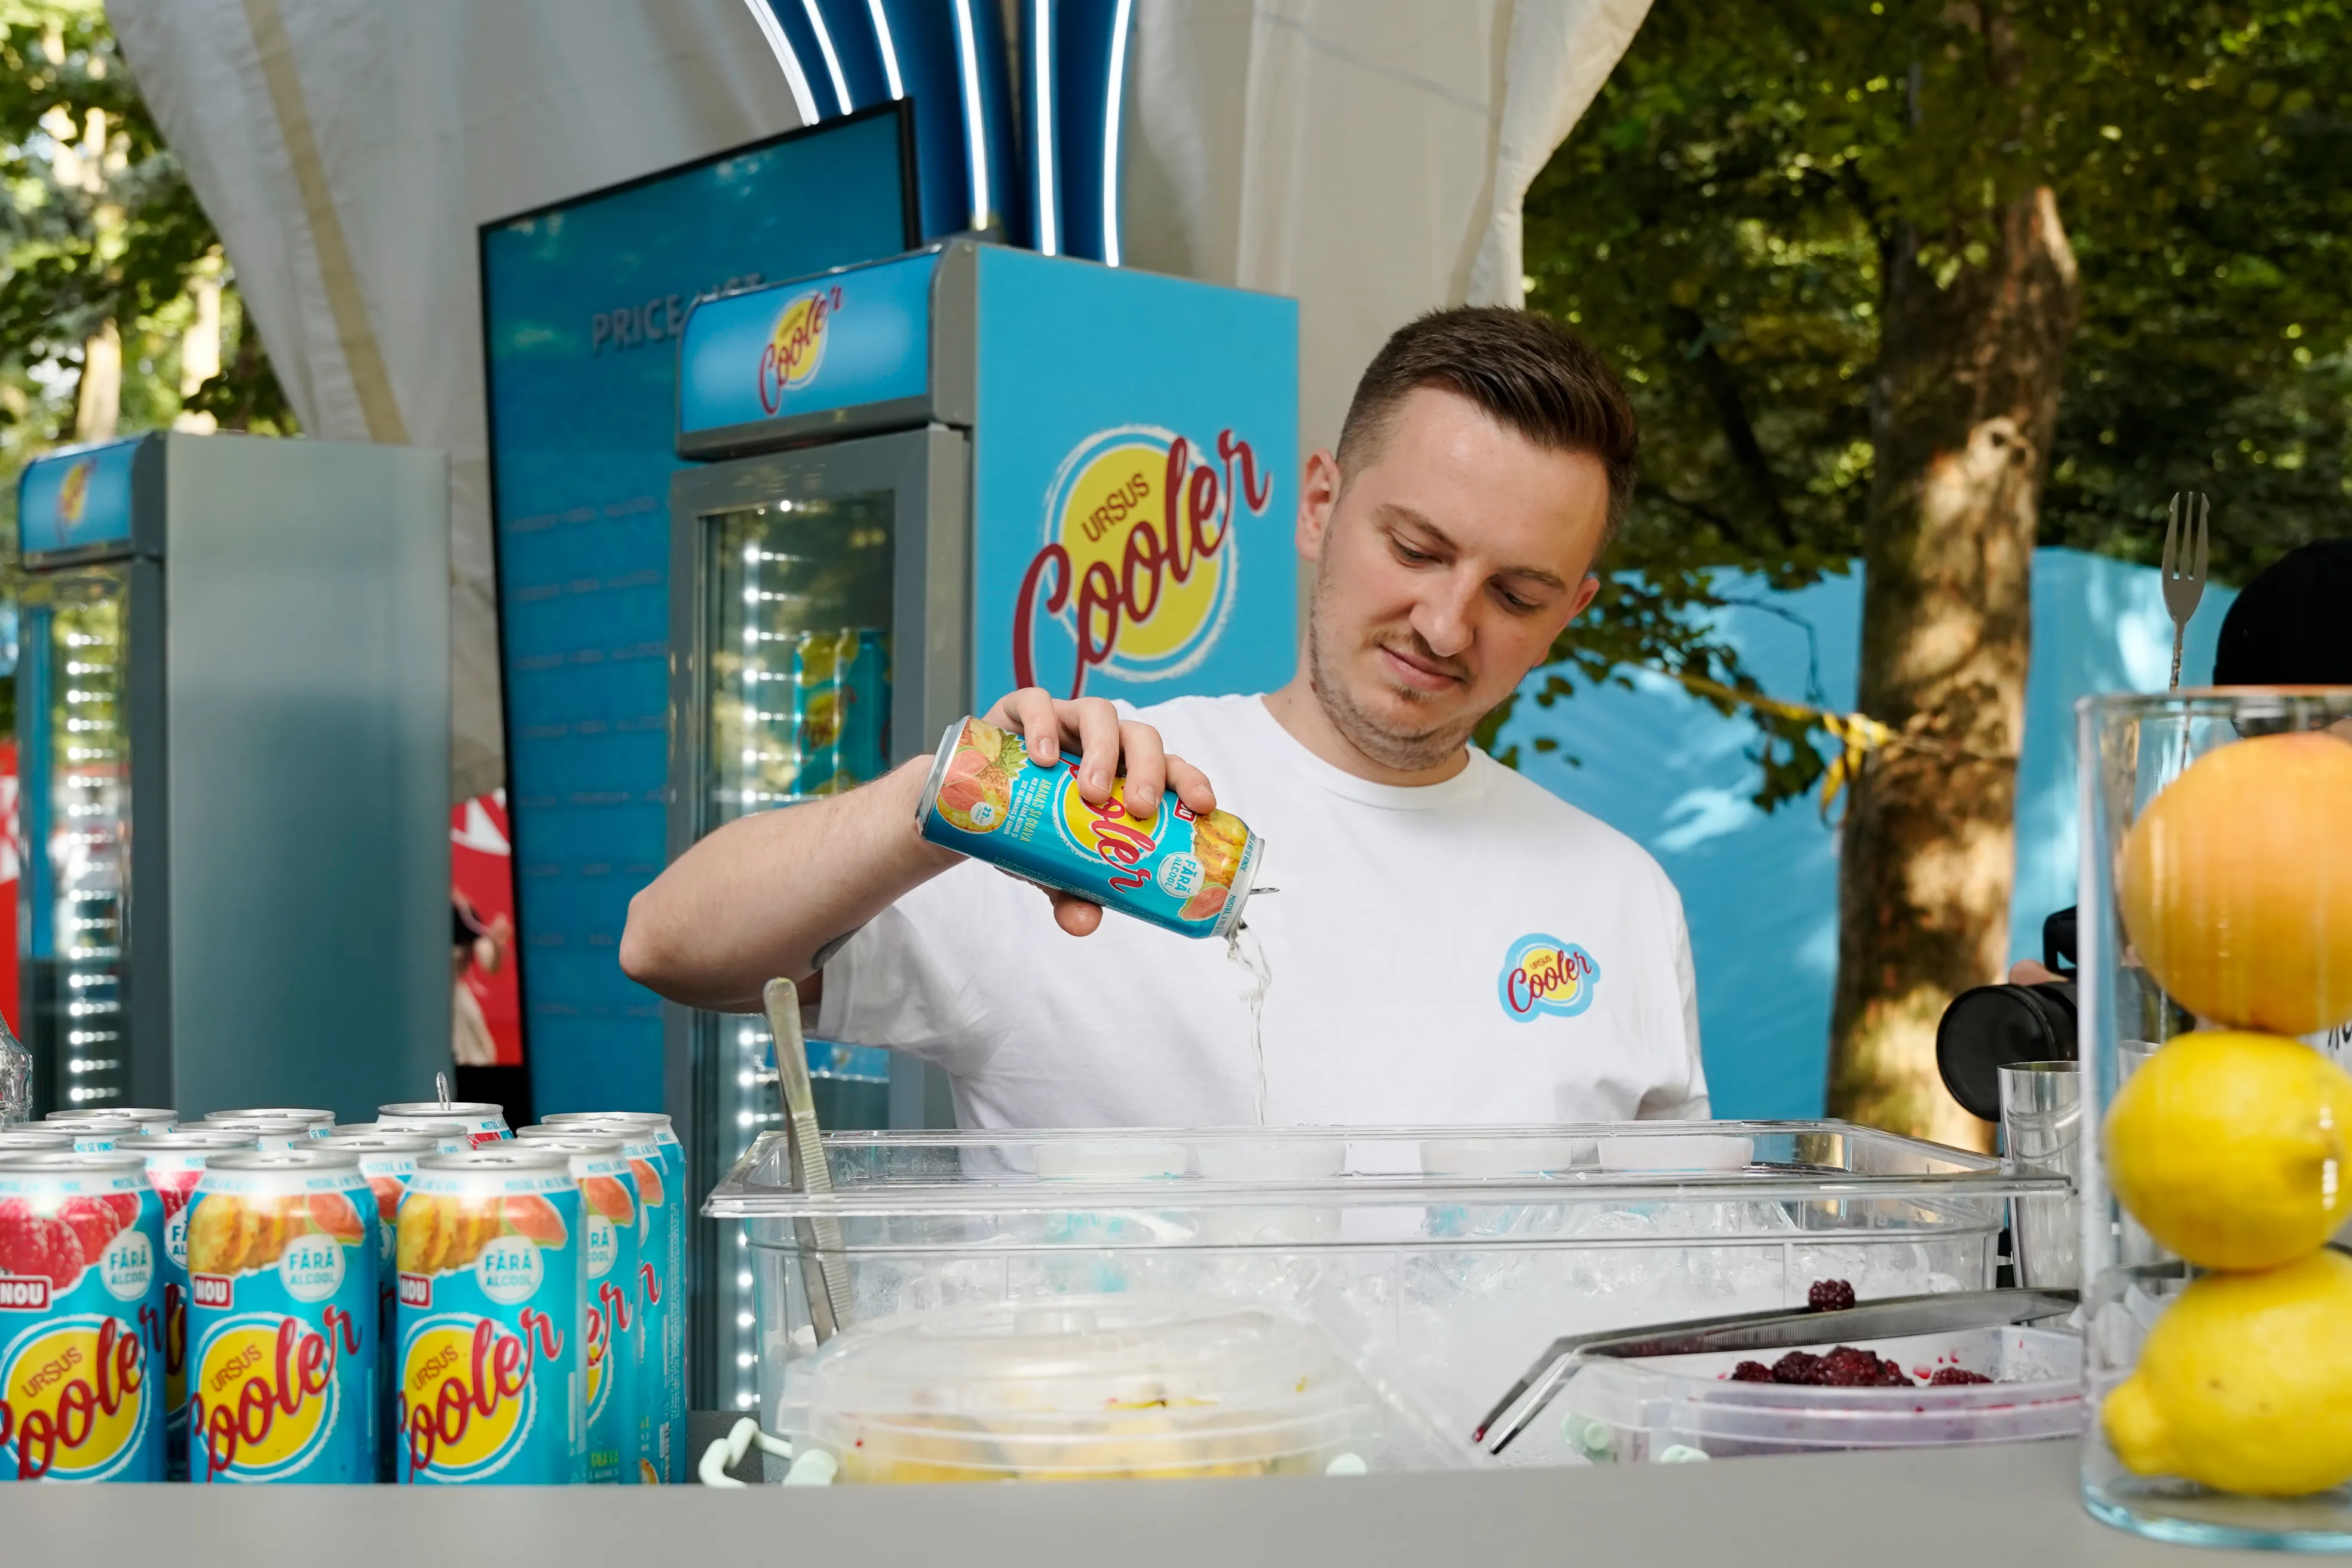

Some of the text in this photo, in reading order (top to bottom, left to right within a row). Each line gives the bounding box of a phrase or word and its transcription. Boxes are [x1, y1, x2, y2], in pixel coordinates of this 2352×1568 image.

[593, 294, 681, 349] PRICE
[1081, 472, 1150, 542] URSUS
[1013, 428, 1270, 700] Cooler
[1011, 795, 1022, 815] ANANAS
[1032, 777, 1052, 810] ANANAS
[1003, 820, 1013, 835] GUAVA
[1019, 818, 1039, 842] GUAVA
[1164, 856, 1179, 887] ALCOOL
[1175, 859, 1197, 894] FĂRĂ
[1529, 954, 1552, 969] URSUS
[1508, 950, 1591, 1012] Cooler
[590, 1227, 610, 1248] RĂ
[110, 1244, 148, 1270] FĂRĂ
[289, 1246, 334, 1270] FĂRĂ
[485, 1249, 532, 1271] FĂRĂ
[111, 1269, 149, 1285] ALCOOL
[290, 1272, 334, 1285] ALCOOL
[486, 1274, 532, 1286] ALCOOL
[0, 1282, 44, 1305] NOU
[195, 1279, 228, 1303] NOU
[401, 1278, 427, 1303] NOU
[21, 1346, 82, 1397] URSUS
[210, 1343, 262, 1392] URSUS
[412, 1344, 458, 1391] URSUS
